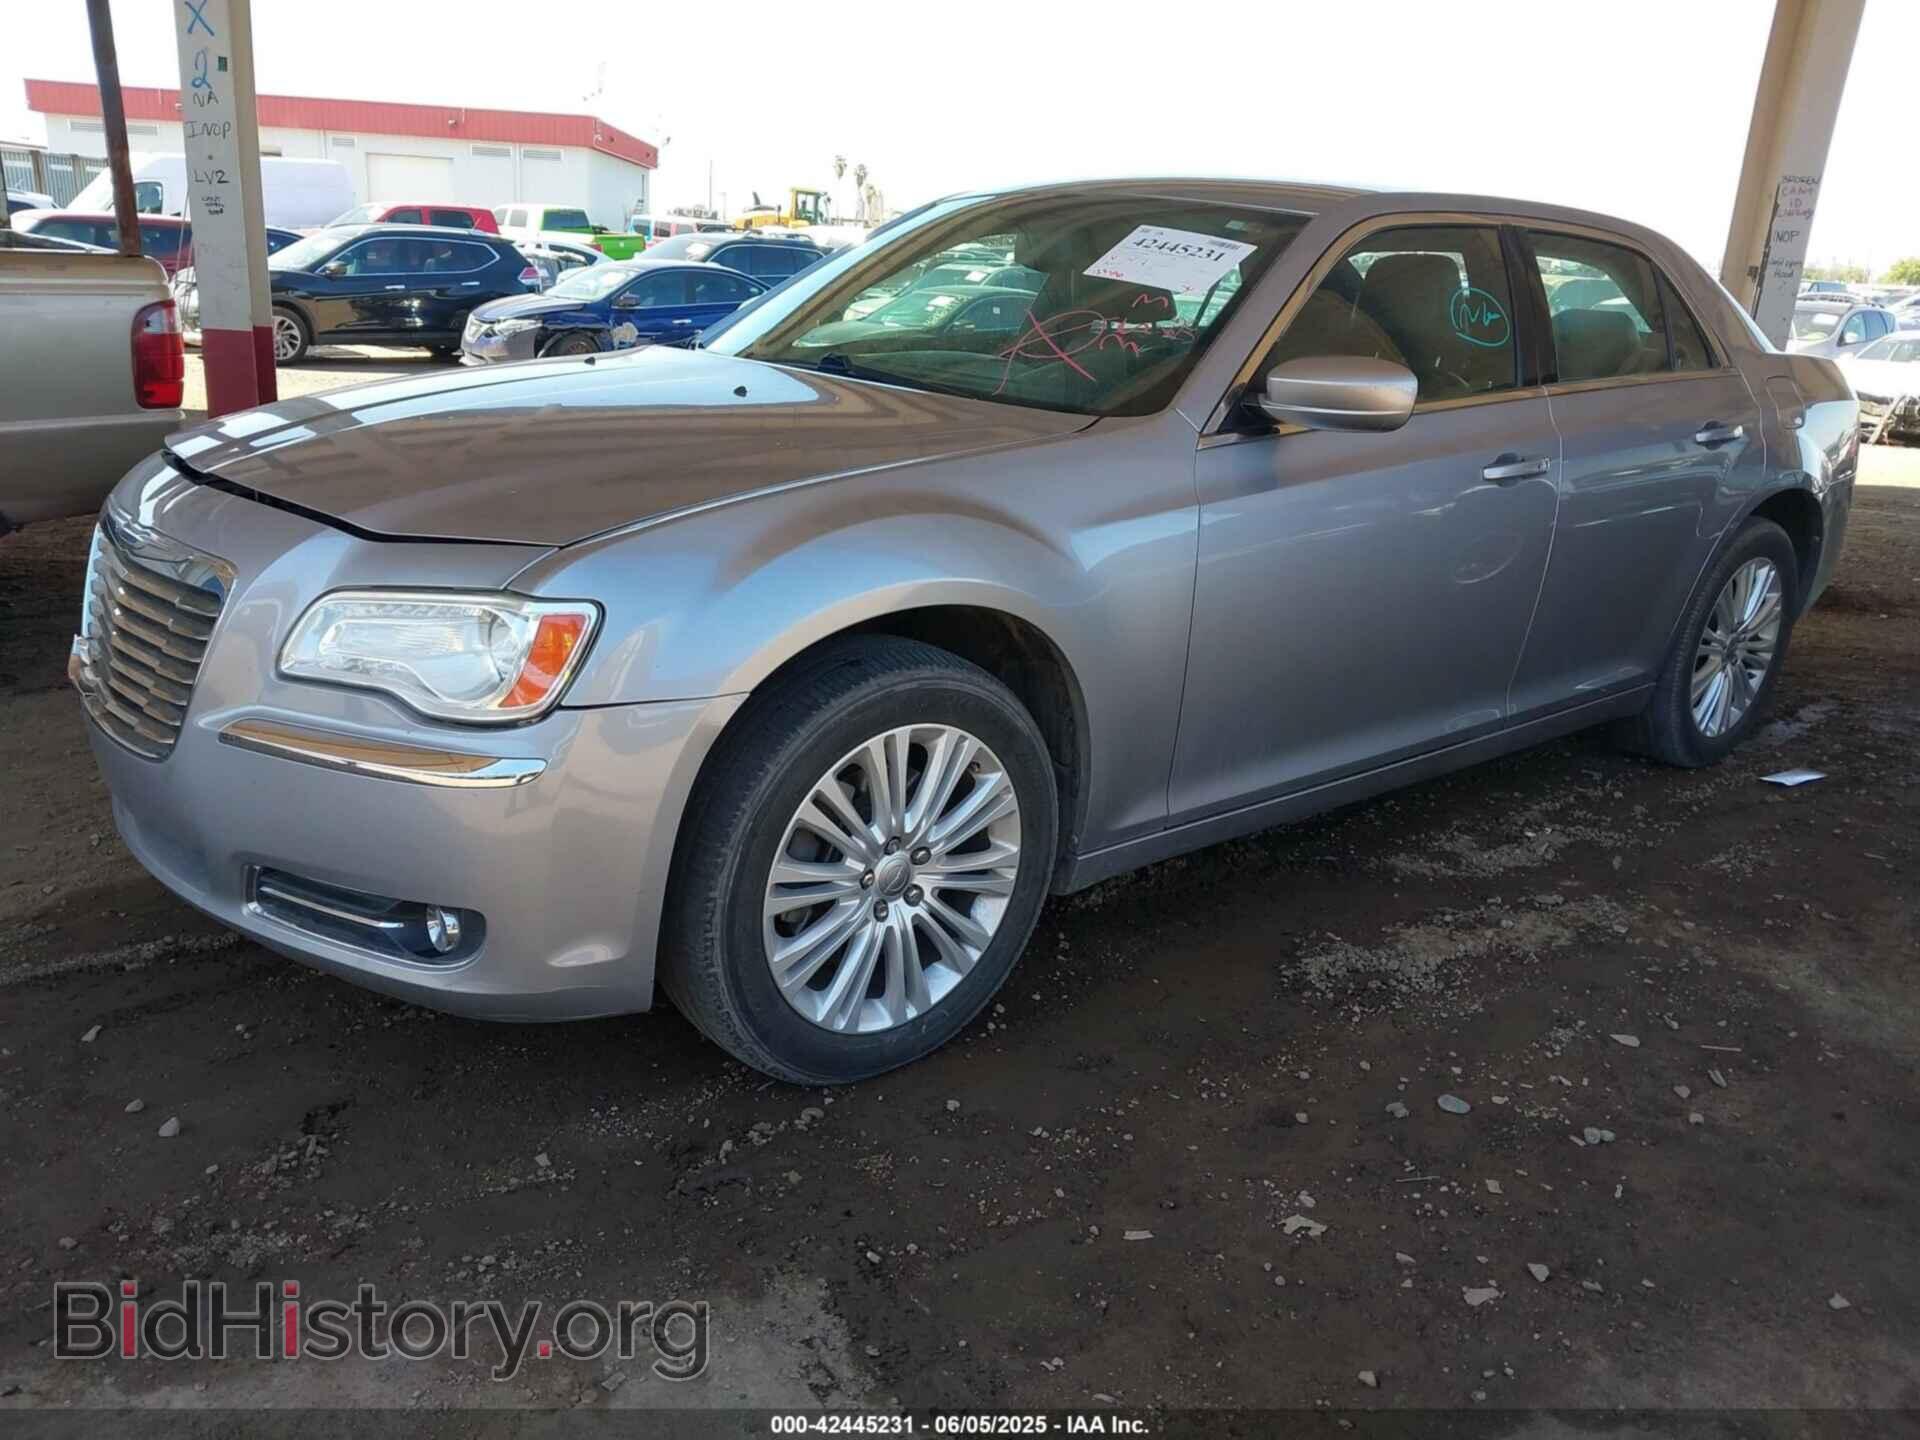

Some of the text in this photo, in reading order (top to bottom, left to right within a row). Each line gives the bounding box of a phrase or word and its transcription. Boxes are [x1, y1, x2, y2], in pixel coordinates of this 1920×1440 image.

[191, 47, 213, 89] 2
[193, 91, 219, 107] NA
[185, 121, 231, 139] INOP
[194, 170, 230, 184] LV2
[1134, 238, 1225, 261] 42445231
